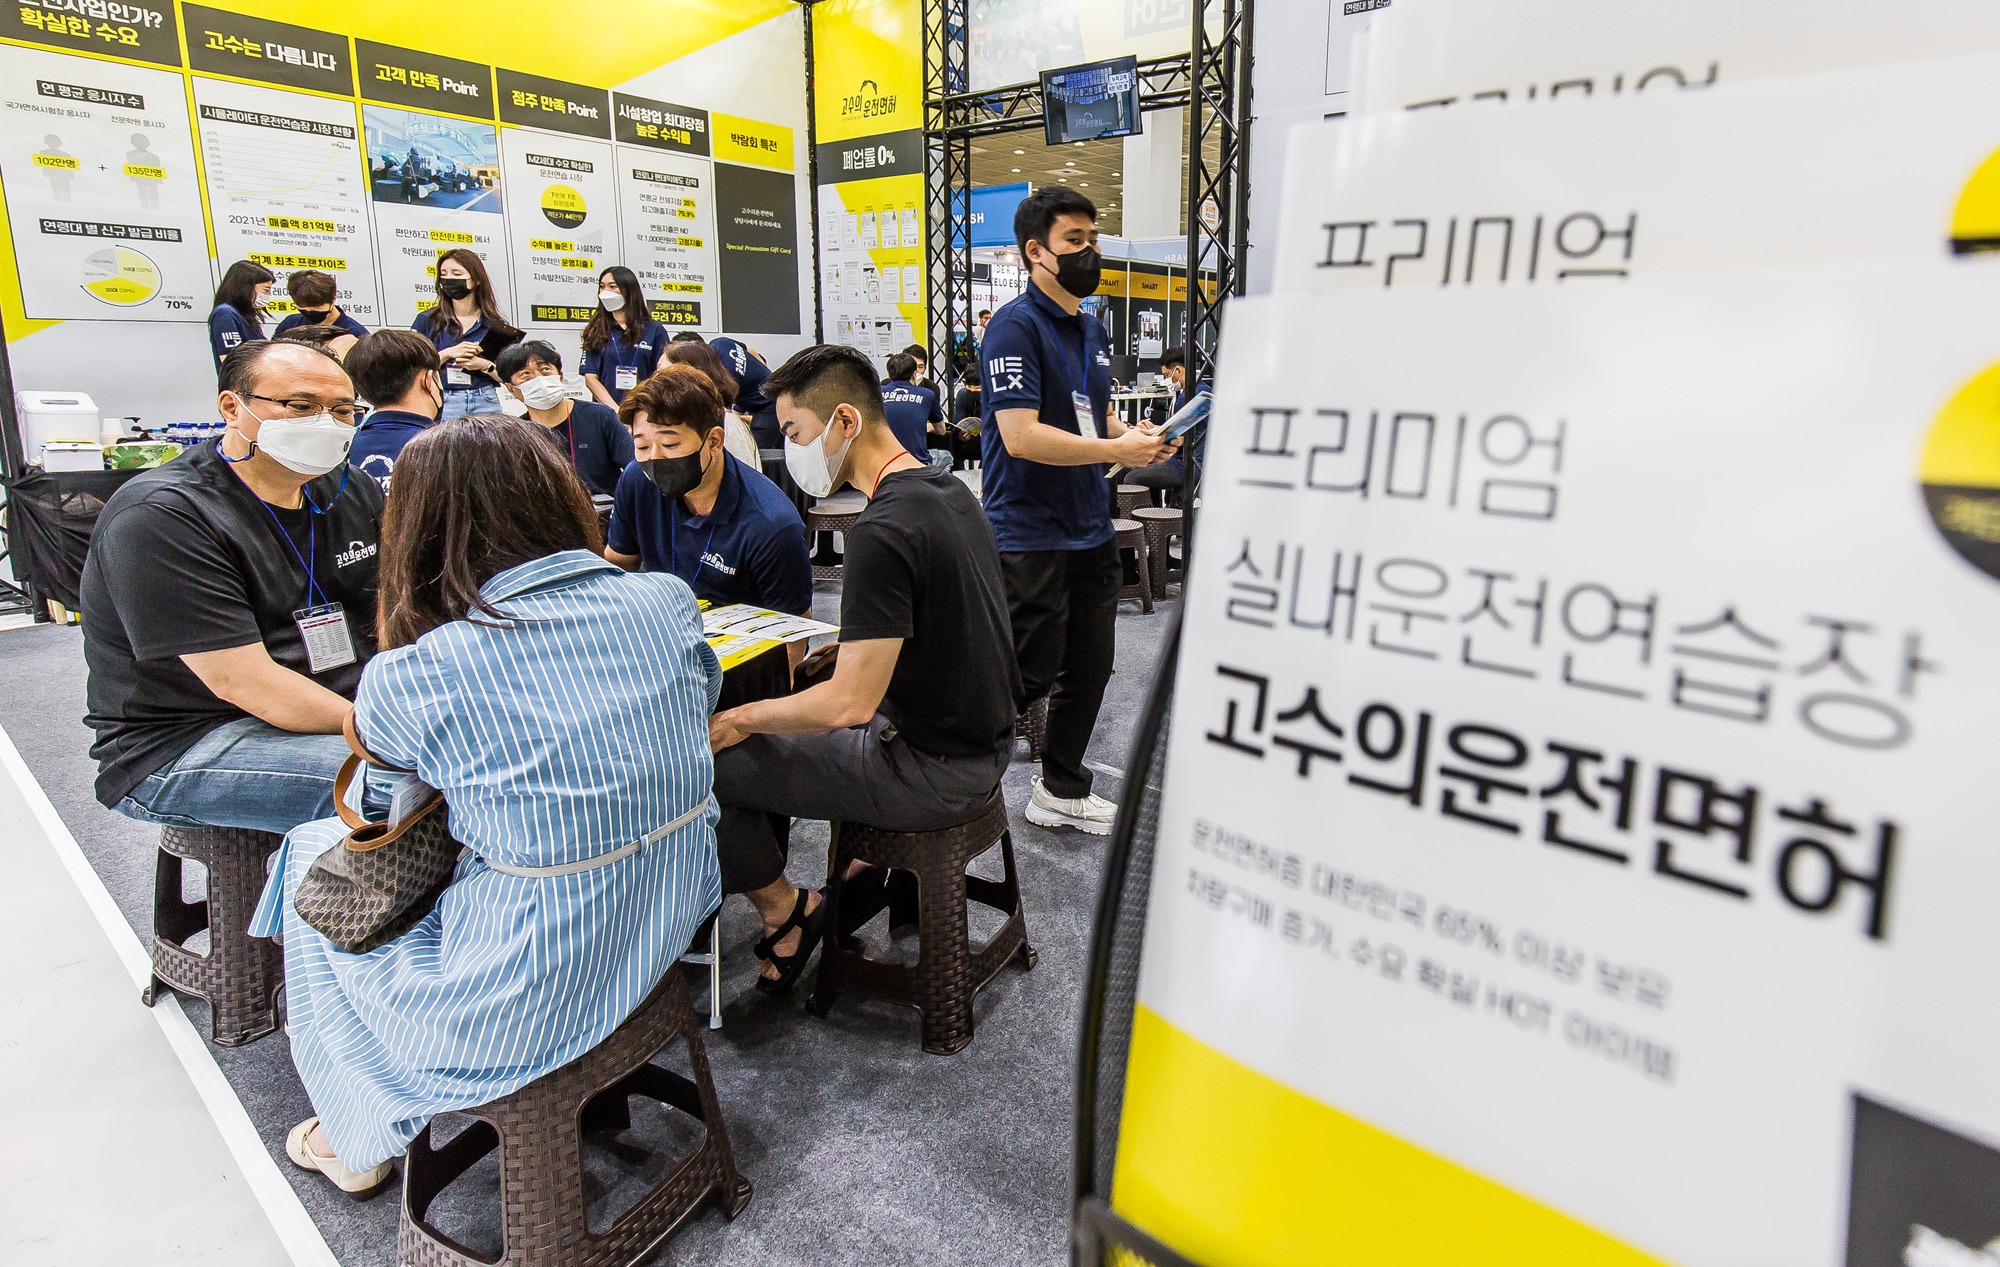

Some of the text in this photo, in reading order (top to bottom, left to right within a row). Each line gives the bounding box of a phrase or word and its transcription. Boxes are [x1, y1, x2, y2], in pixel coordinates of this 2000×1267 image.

[20, 7, 140, 46] 확실한 수요
[204, 31, 338, 72] 고수는 다릅니다
[375, 64, 479, 97] 고객 만족 Point
[41, 82, 141, 107] 연 평균 응시자 수
[512, 90, 598, 119] 점주 만족 Point
[842, 94, 896, 118] 고수의 운전면허
[204, 107, 352, 138] 시뮬레이터 운전연습장 시장 현황
[618, 104, 705, 132] 시설창업 최대장점
[636, 122, 691, 146] 높은 수익률
[730, 132, 778, 152] 박람회 특전
[37, 156, 76, 168] 102만명
[556, 159, 570, 168] 수요
[843, 145, 895, 170] 폐업률 0%
[127, 166, 162, 178] 135만명
[683, 199, 695, 207] 35%
[678, 210, 695, 218] 79.9%
[43, 220, 180, 242] 연령대 별 신규 발급 비율
[229, 215, 356, 234] 2021년 매출액 81억원 달성
[396, 228, 491, 244] 편안하고 안전한 환경 에서
[402, 247, 436, 258] 학원대비
[532, 240, 602, 253] 수익률 높은 시설창업
[250, 254, 347, 269] 업계 최초 프랜차이즈
[532, 257, 588, 268] 안정적인 운영지출
[533, 274, 574, 283] 지속발전되는
[165, 301, 192, 310] 70%
[353, 305, 372, 313] 달성
[537, 307, 567, 319] 폐업률
[570, 309, 590, 320] 제로
[651, 311, 698, 324] 무려 79.9%
[1239, 406, 1569, 522] 프리미엄
[1223, 534, 1940, 753] 실내운전연습장
[1204, 662, 1901, 943] 고수의운전면허
[1511, 926, 1587, 986] 이상
